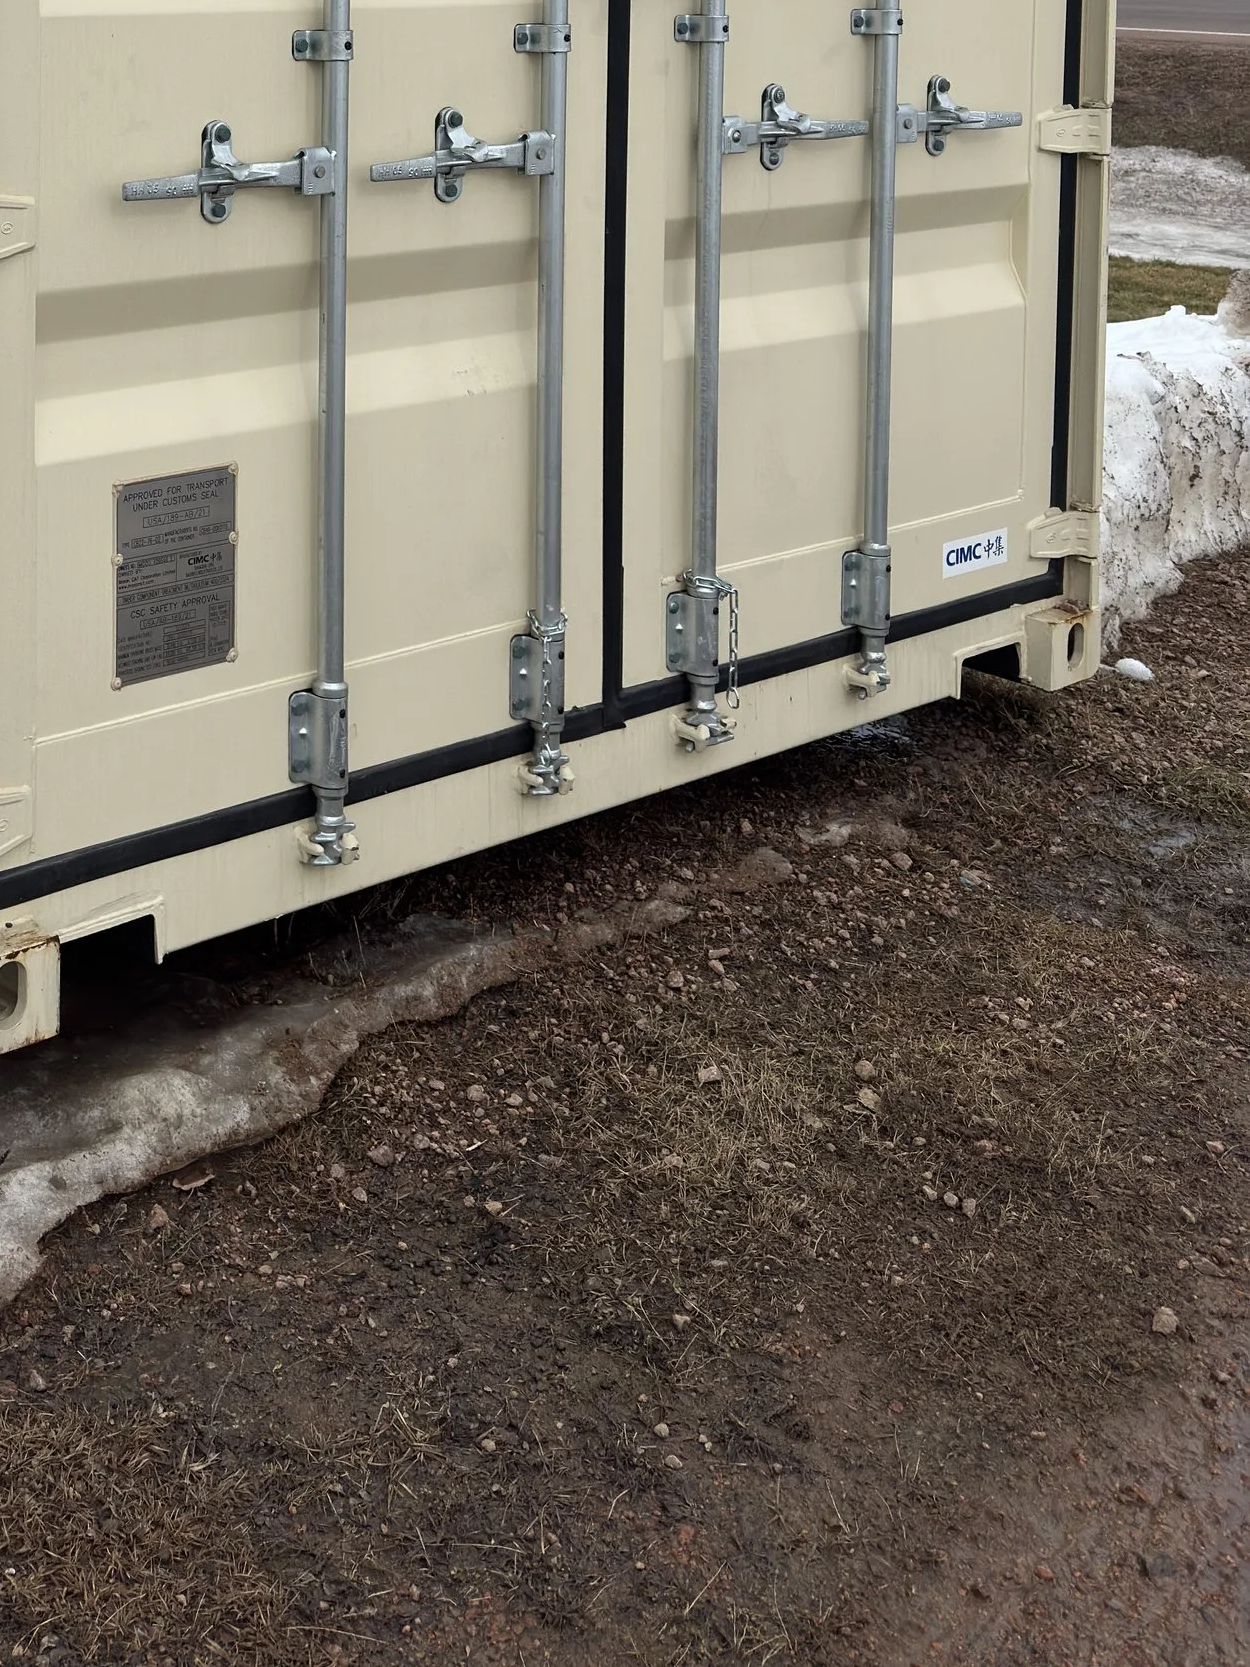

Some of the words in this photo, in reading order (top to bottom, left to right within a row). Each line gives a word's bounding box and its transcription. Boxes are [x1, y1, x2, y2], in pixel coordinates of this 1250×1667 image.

[123, 488, 163, 503] APPROVED
[166, 485, 182, 495] FOR
[186, 477, 229, 491] TRANSPORT
[132, 500, 159, 512] UNDER
[162, 493, 197, 507] CUSTOMS
[201, 490, 219, 500] SEAL
[187, 554, 209, 566] CIMC
[947, 543, 981, 566] CIMC
[130, 608, 146, 620] CSC
[149, 600, 178, 615] SAFETY
[181, 593, 220, 607] APPROVAL
